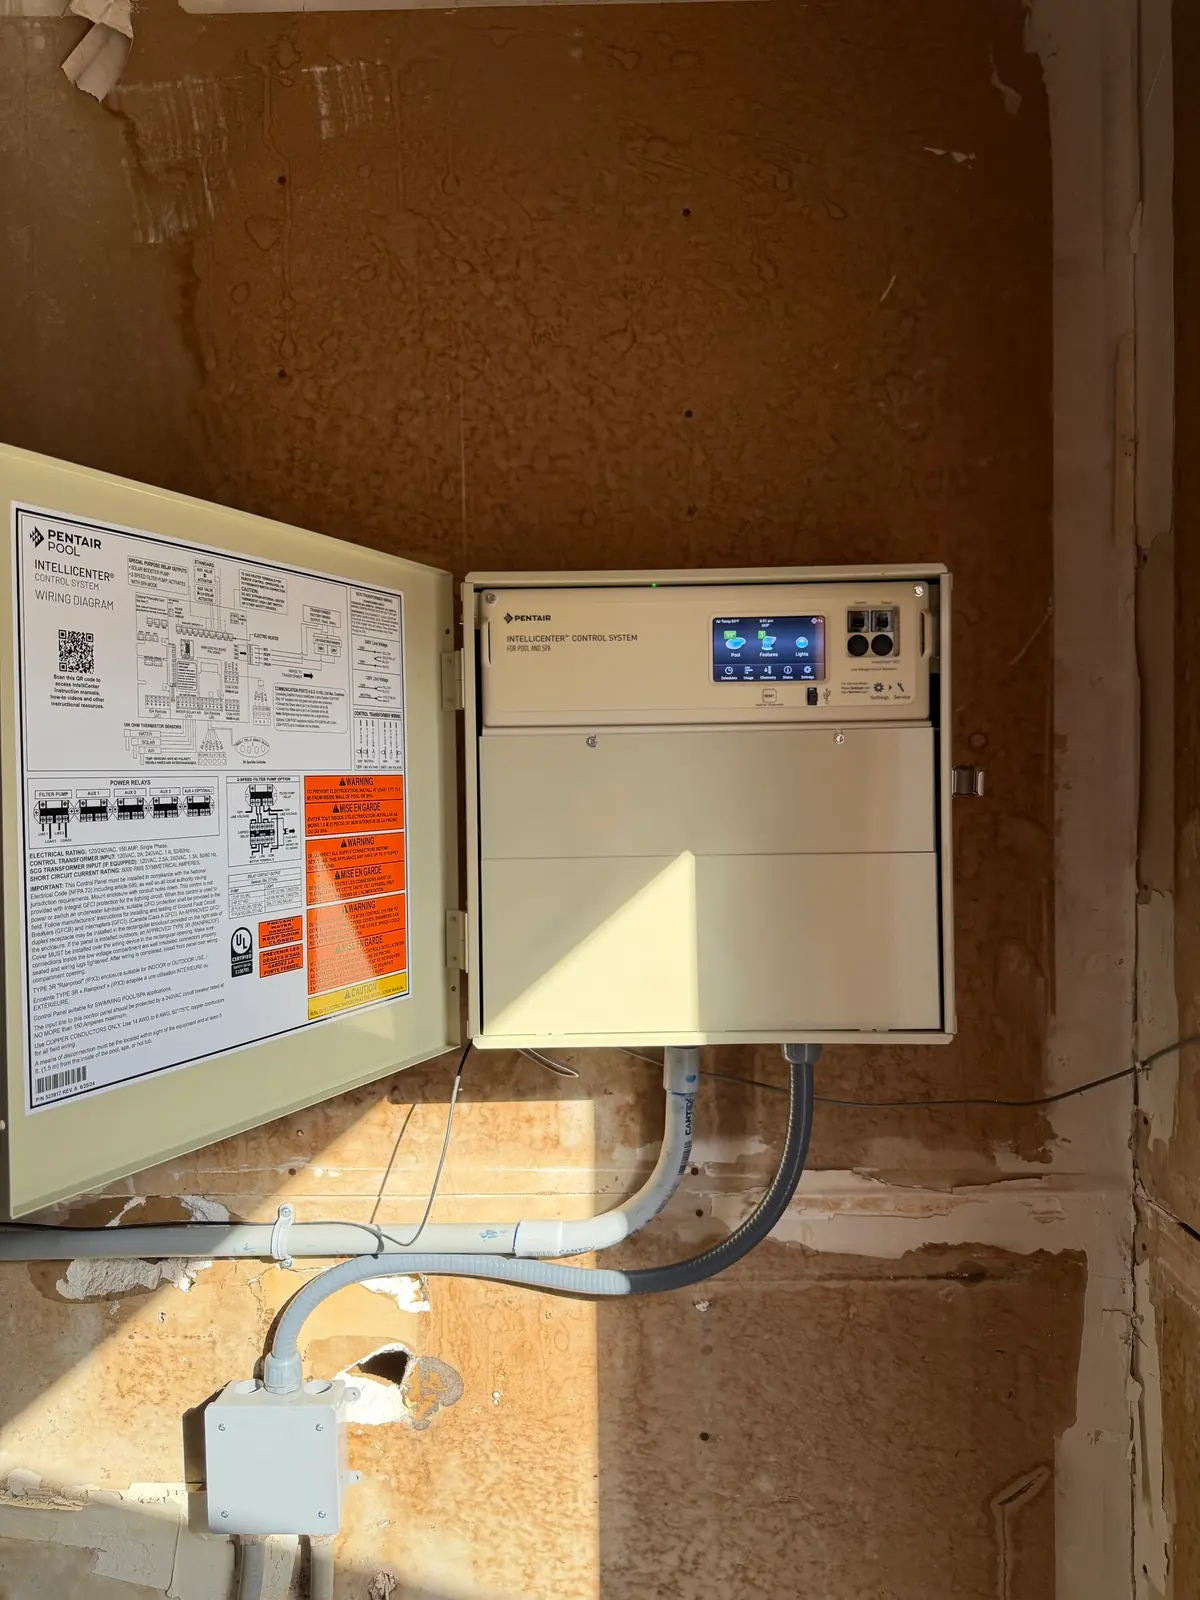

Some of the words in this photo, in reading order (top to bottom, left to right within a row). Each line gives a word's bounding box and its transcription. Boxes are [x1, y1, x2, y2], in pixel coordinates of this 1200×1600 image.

[47, 528, 101, 549] PENTAIR
[48, 541, 80, 557] POOL
[34, 558, 115, 583] INTELLICENTER®
[34, 571, 70, 586] CONTROL
[71, 578, 99, 591] SYSTEM
[34, 588, 71, 604] WIRING
[73, 594, 114, 610] DIAGRAM
[514, 614, 551, 622] PENTAIR
[571, 634, 607, 642] CONTROL
[609, 634, 638, 642] SYSTEM
[506, 644, 517, 652] FOR
[517, 644, 530, 652] POOL
[530, 644, 541, 652] AND
[541, 644, 552, 652] SPA
[346, 777, 373, 786] WARNING
[339, 803, 352, 812] MISE
[353, 803, 361, 812] EN
[361, 802, 380, 811] GARDE
[347, 836, 374, 847] WARNING
[29, 850, 64, 859] ELECTRICAL
[65, 848, 86, 856] RATING:
[29, 858, 56, 867] CONTROL
[58, 855, 98, 864] TRANSFORMER
[29, 874, 49, 882] SHORT
[50, 872, 72, 880] CIRCUIT
[73, 869, 98, 877] CURRENT
[100, 867, 119, 875] RATING:
[43, 863, 84, 873] TRANSFORMER
[340, 868, 354, 879] MISE
[355, 867, 362, 877] EN
[363, 865, 381, 876] GARDE
[30, 883, 63, 892] IMPORTANT:
[348, 900, 375, 912] WARNING
[266, 918, 293, 926] PREVENT
[236, 932, 247, 950] UL
[268, 936, 294, 945] CLOSED
[341, 940, 355, 952] MISE
[356, 938, 363, 948] EN
[365, 934, 382, 947] GARDE
[231, 953, 251, 962] CERTIFIED
[351, 982, 376, 997] CAUTION
[33, 1012, 51, 1021] Control
[52, 1009, 66, 1017] Panel
[68, 1004, 86, 1013] suitable
[94, 997, 121, 1007] SWIMMING
[34, 1031, 42, 1039] NO
[44, 1027, 60, 1036] MORE
[61, 1024, 72, 1032] than
[83, 1017, 103, 1027] Amperes
[45, 1035, 68, 1046] COPPER
[69, 1025, 106, 1039] CONDUCTORS
[685, 1098, 693, 1136] CANTEX
